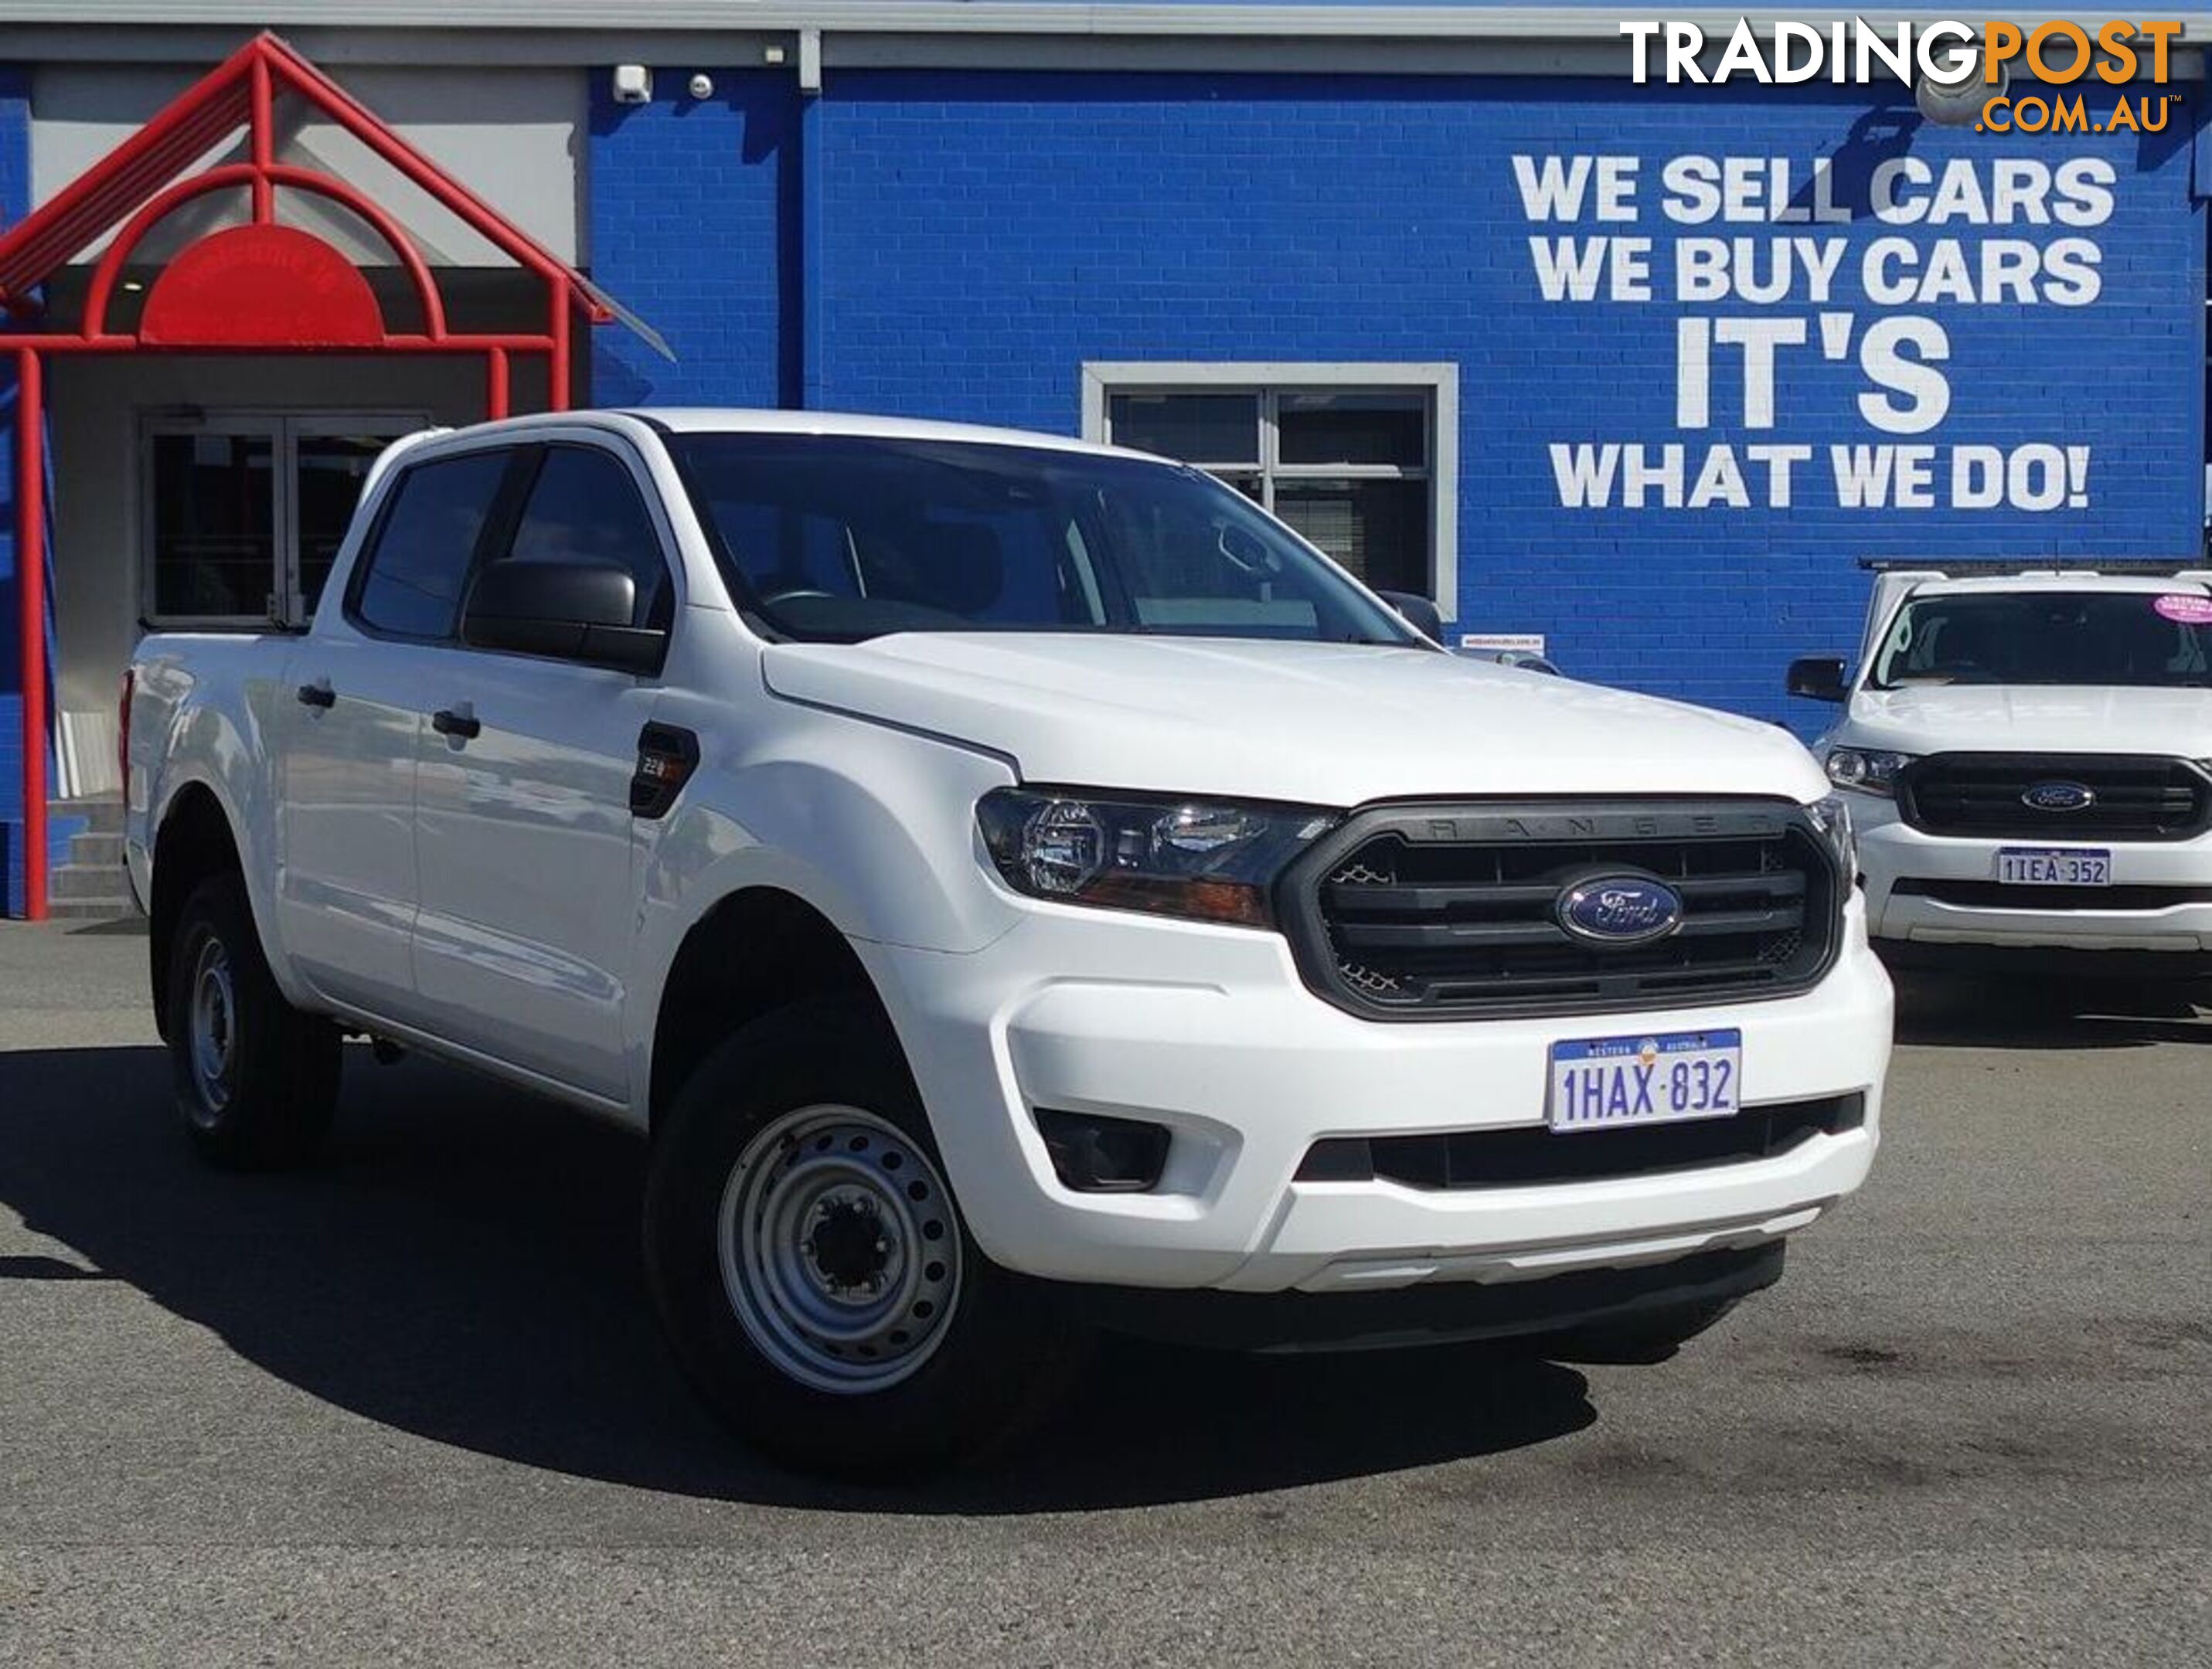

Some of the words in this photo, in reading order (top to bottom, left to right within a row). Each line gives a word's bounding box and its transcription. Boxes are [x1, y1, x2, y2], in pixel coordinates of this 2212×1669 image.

[1513, 155, 1639, 223] WE
[1662, 155, 1852, 225] SELL
[1870, 156, 2116, 226] CARS
[1529, 236, 1652, 302] WE
[1676, 236, 1848, 304] BUY
[1862, 236, 2102, 306] CARS
[1676, 312, 1951, 435] IT'S
[1549, 444, 1812, 508] WHAT
[1830, 444, 1936, 508] WE
[1951, 443, 2091, 511] DO!
[1596, 890, 1659, 926] Ford
